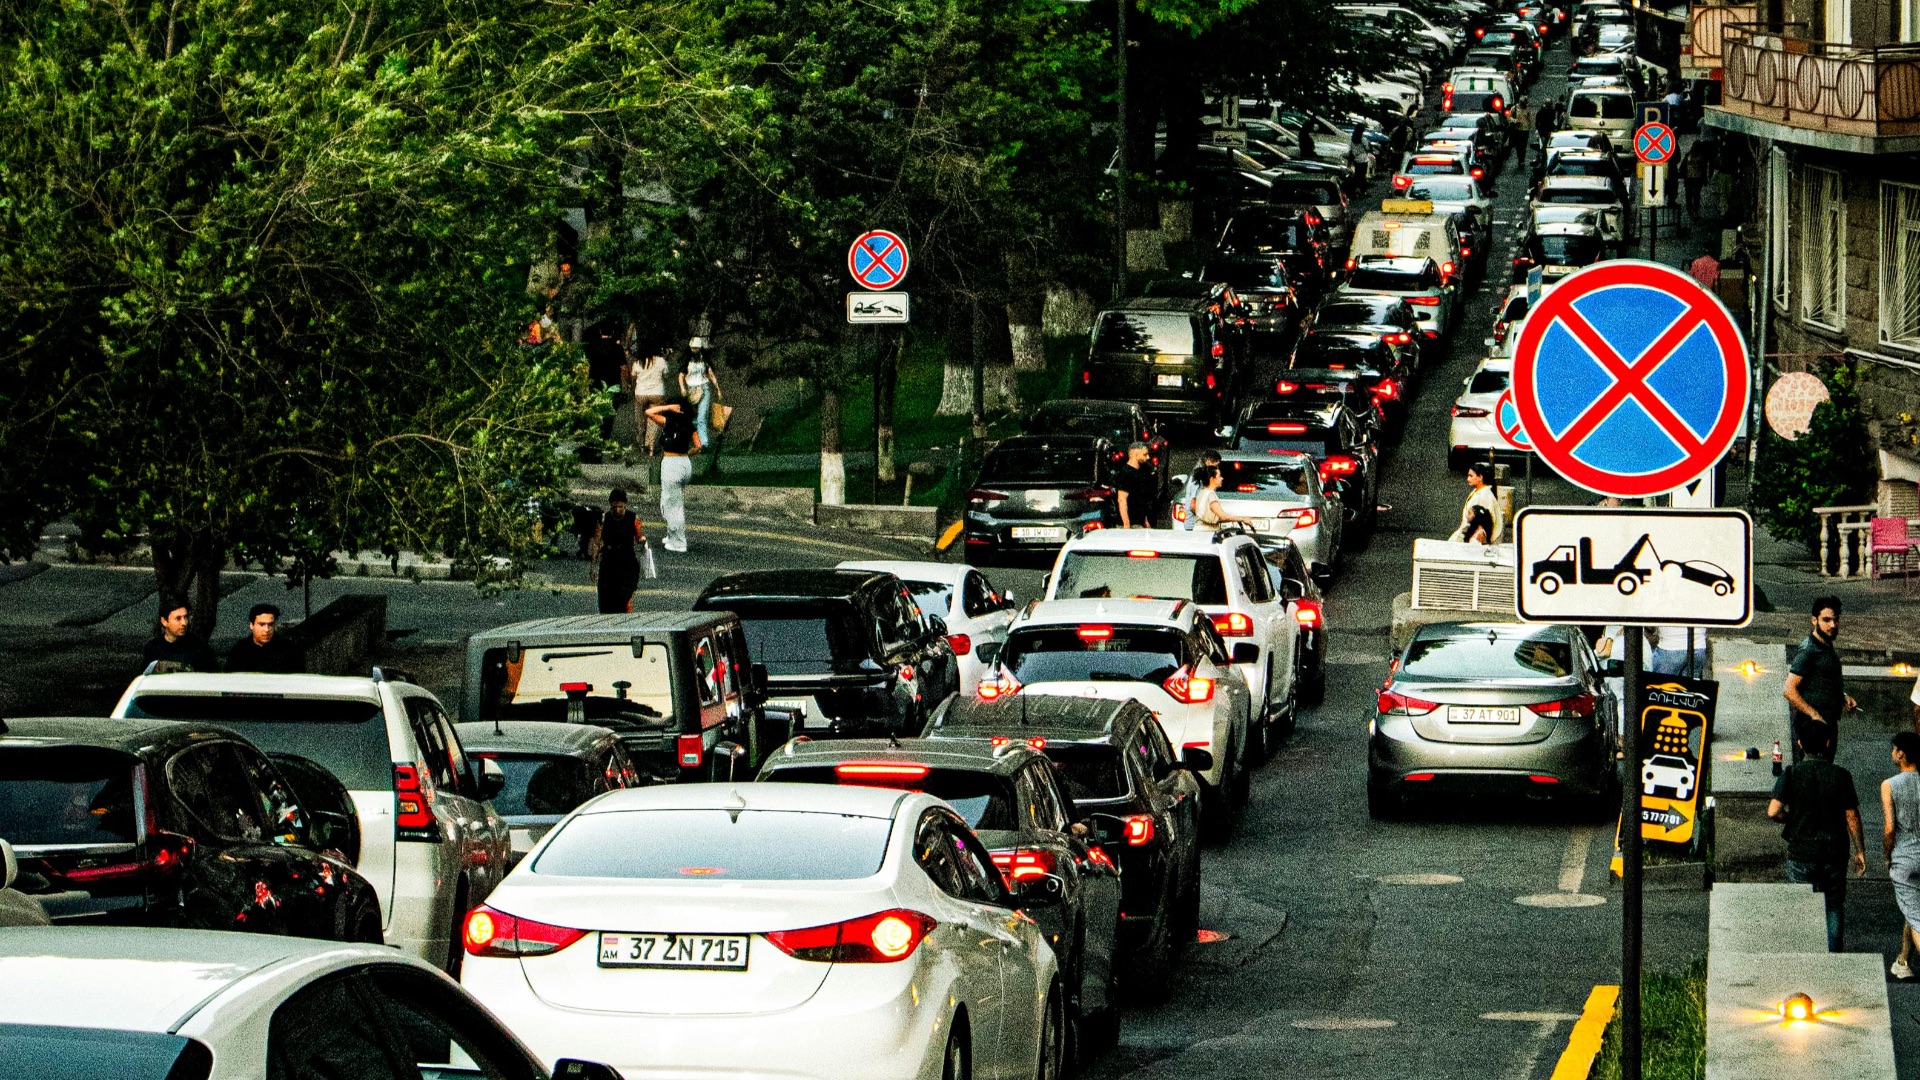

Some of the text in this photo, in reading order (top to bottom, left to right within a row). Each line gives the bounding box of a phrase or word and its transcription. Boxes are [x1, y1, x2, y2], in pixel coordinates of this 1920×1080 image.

[1463, 709, 1515, 721] 37 AT 901
[602, 950, 618, 959] AM
[630, 937, 740, 962] 37 ZN 715
